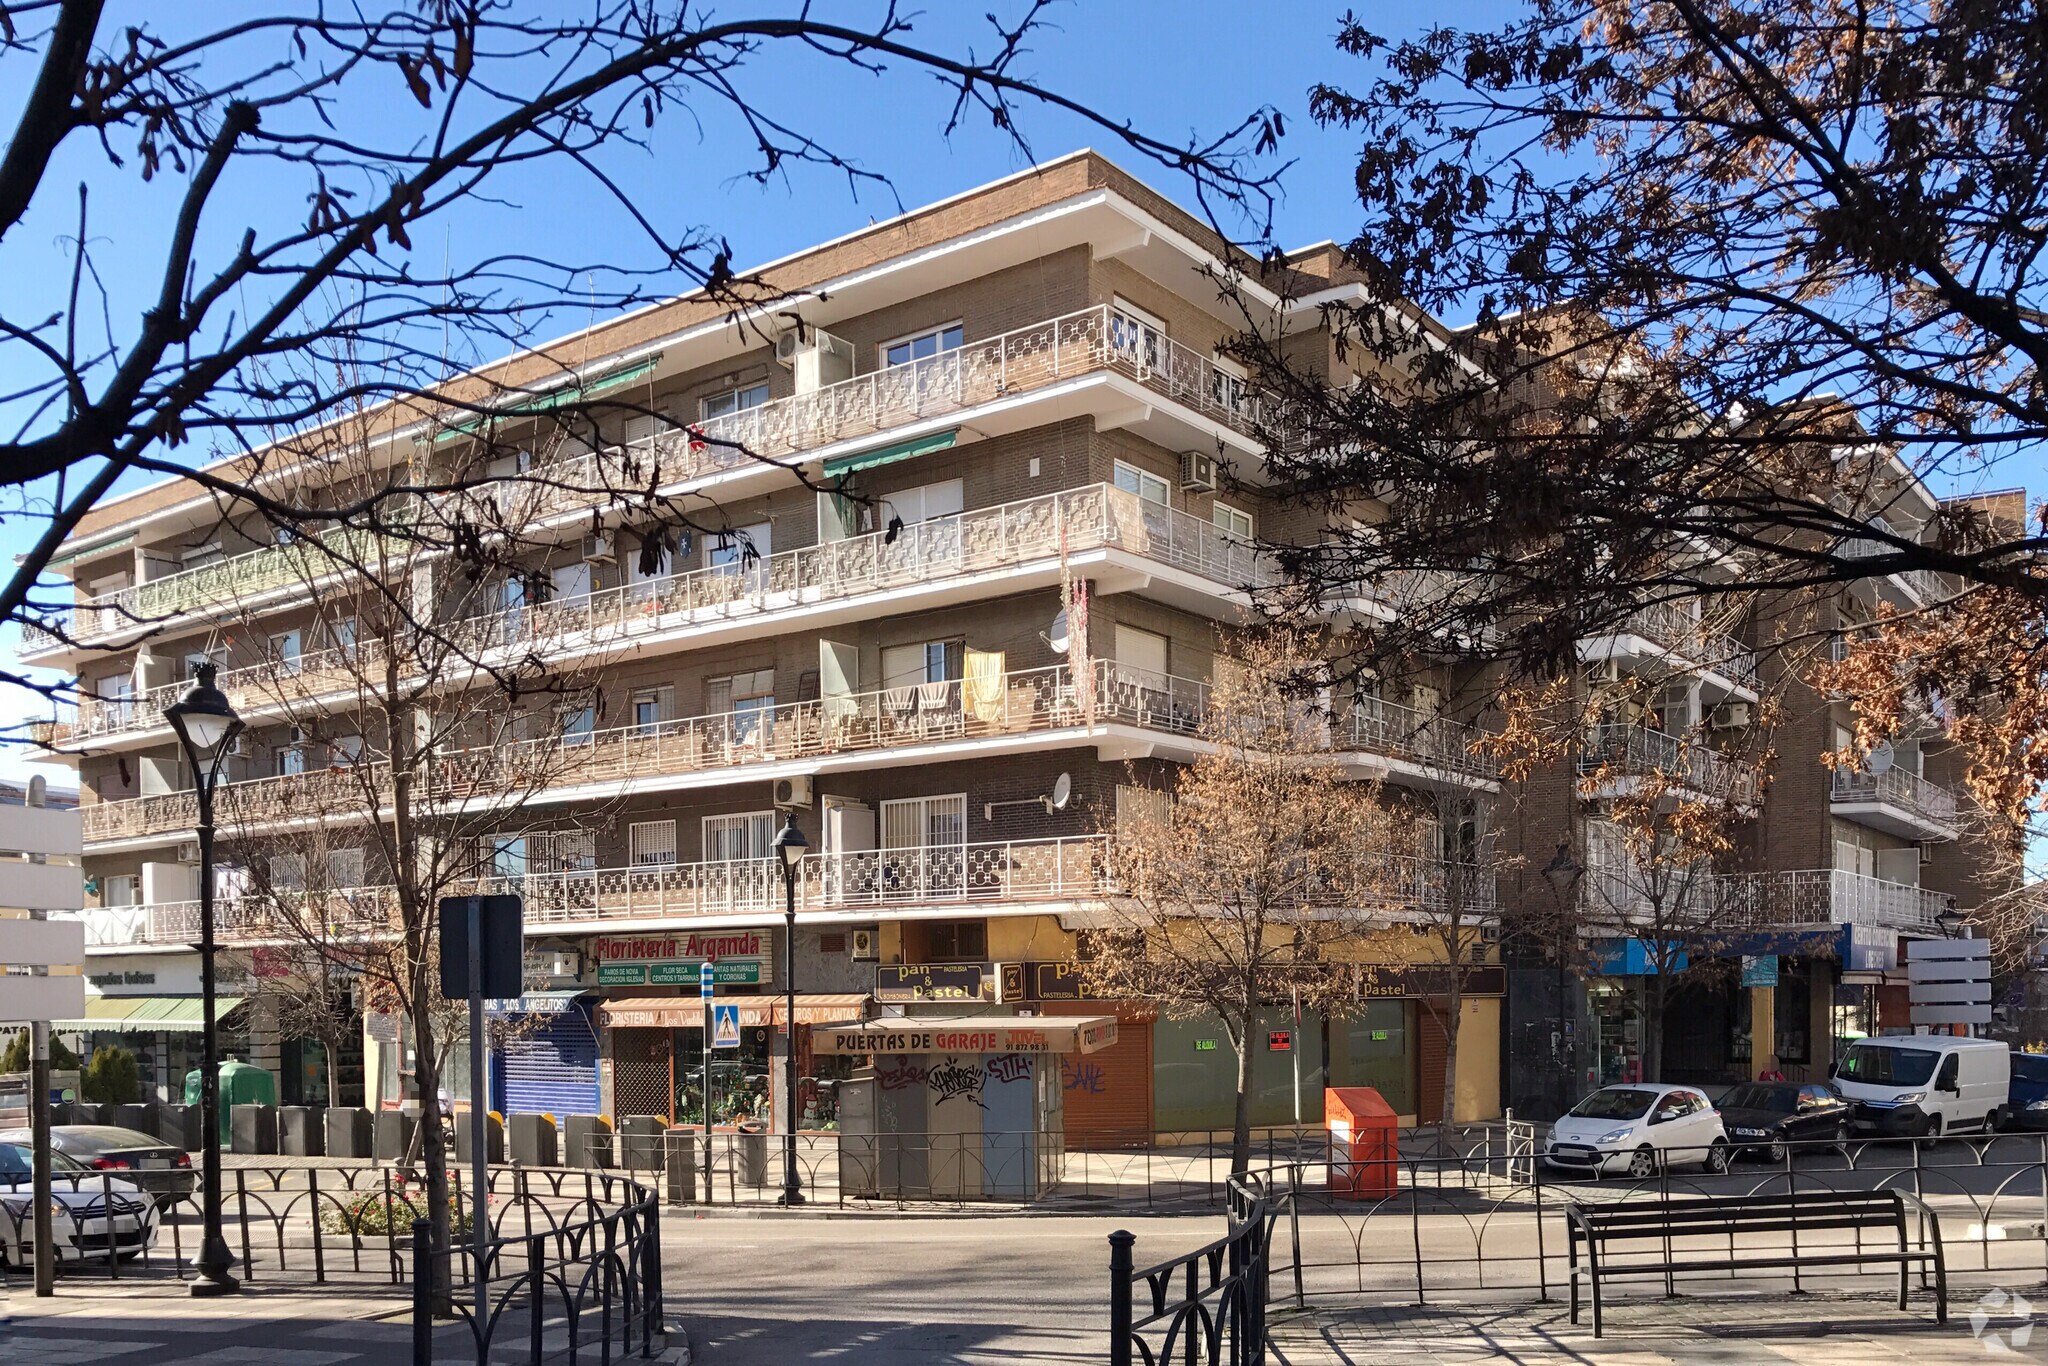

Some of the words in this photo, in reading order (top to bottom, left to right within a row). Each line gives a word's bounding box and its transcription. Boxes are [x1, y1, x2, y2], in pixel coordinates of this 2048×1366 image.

[685, 932, 760, 962] Arganda
[619, 968, 626, 976] DE
[676, 966, 688, 974] SECA
[713, 965, 729, 973] ANTAS
[730, 964, 758, 972] NATURALES
[1361, 964, 1377, 973] an
[652, 974, 673, 982] CENTROS
[723, 973, 747, 981] CORONAS
[924, 975, 933, 987] &
[600, 1010, 655, 1025] FLORISTERIA
[779, 1007, 812, 1021] CETROS
[823, 1007, 857, 1021] PLANTAS
[836, 1033, 905, 1051] PUERTAS
[911, 1033, 931, 1049] DE
[936, 1032, 997, 1052] GARAJE
[1005, 1043, 1014, 1051] 91
[1015, 1043, 1028, 1051] 872
[1029, 1043, 1040, 1051] 98
[1041, 1043, 1049, 1051] 31
